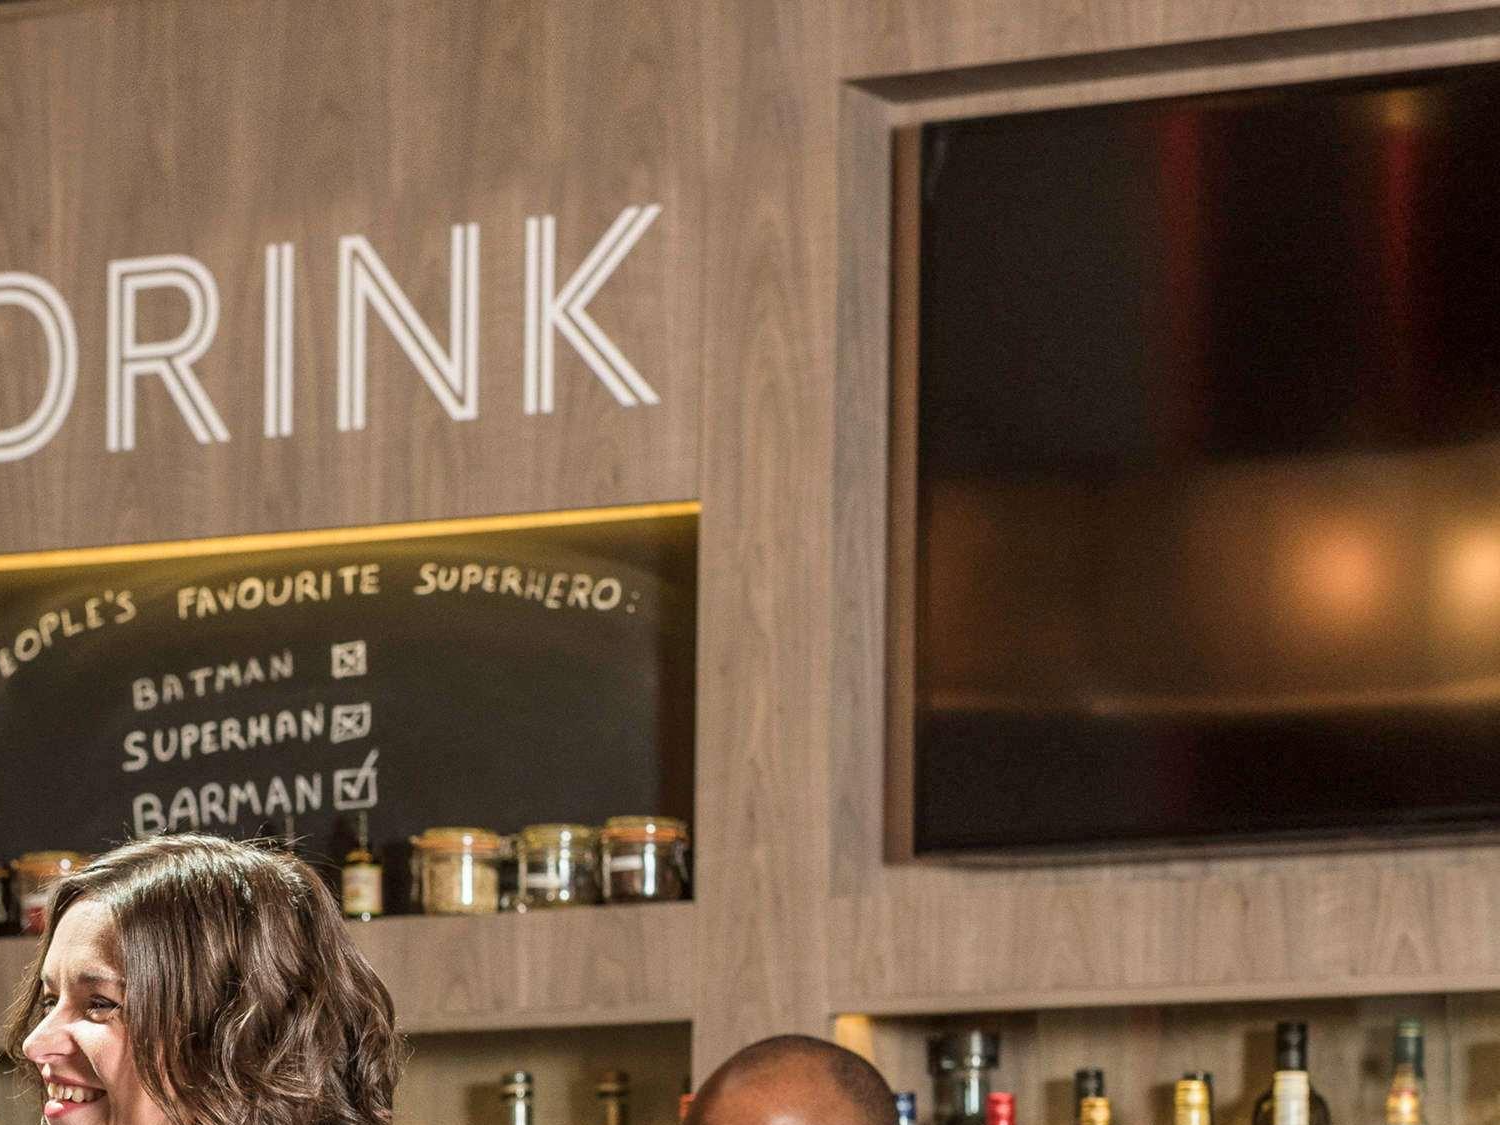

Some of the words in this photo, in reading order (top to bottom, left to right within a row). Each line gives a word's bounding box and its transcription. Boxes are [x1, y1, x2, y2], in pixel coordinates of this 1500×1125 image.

[176, 563, 382, 621] FAVOURITE
[412, 561, 642, 614] SUPERHERO:
[131, 648, 295, 713] BATMAN
[132, 771, 323, 839] BARMAN
